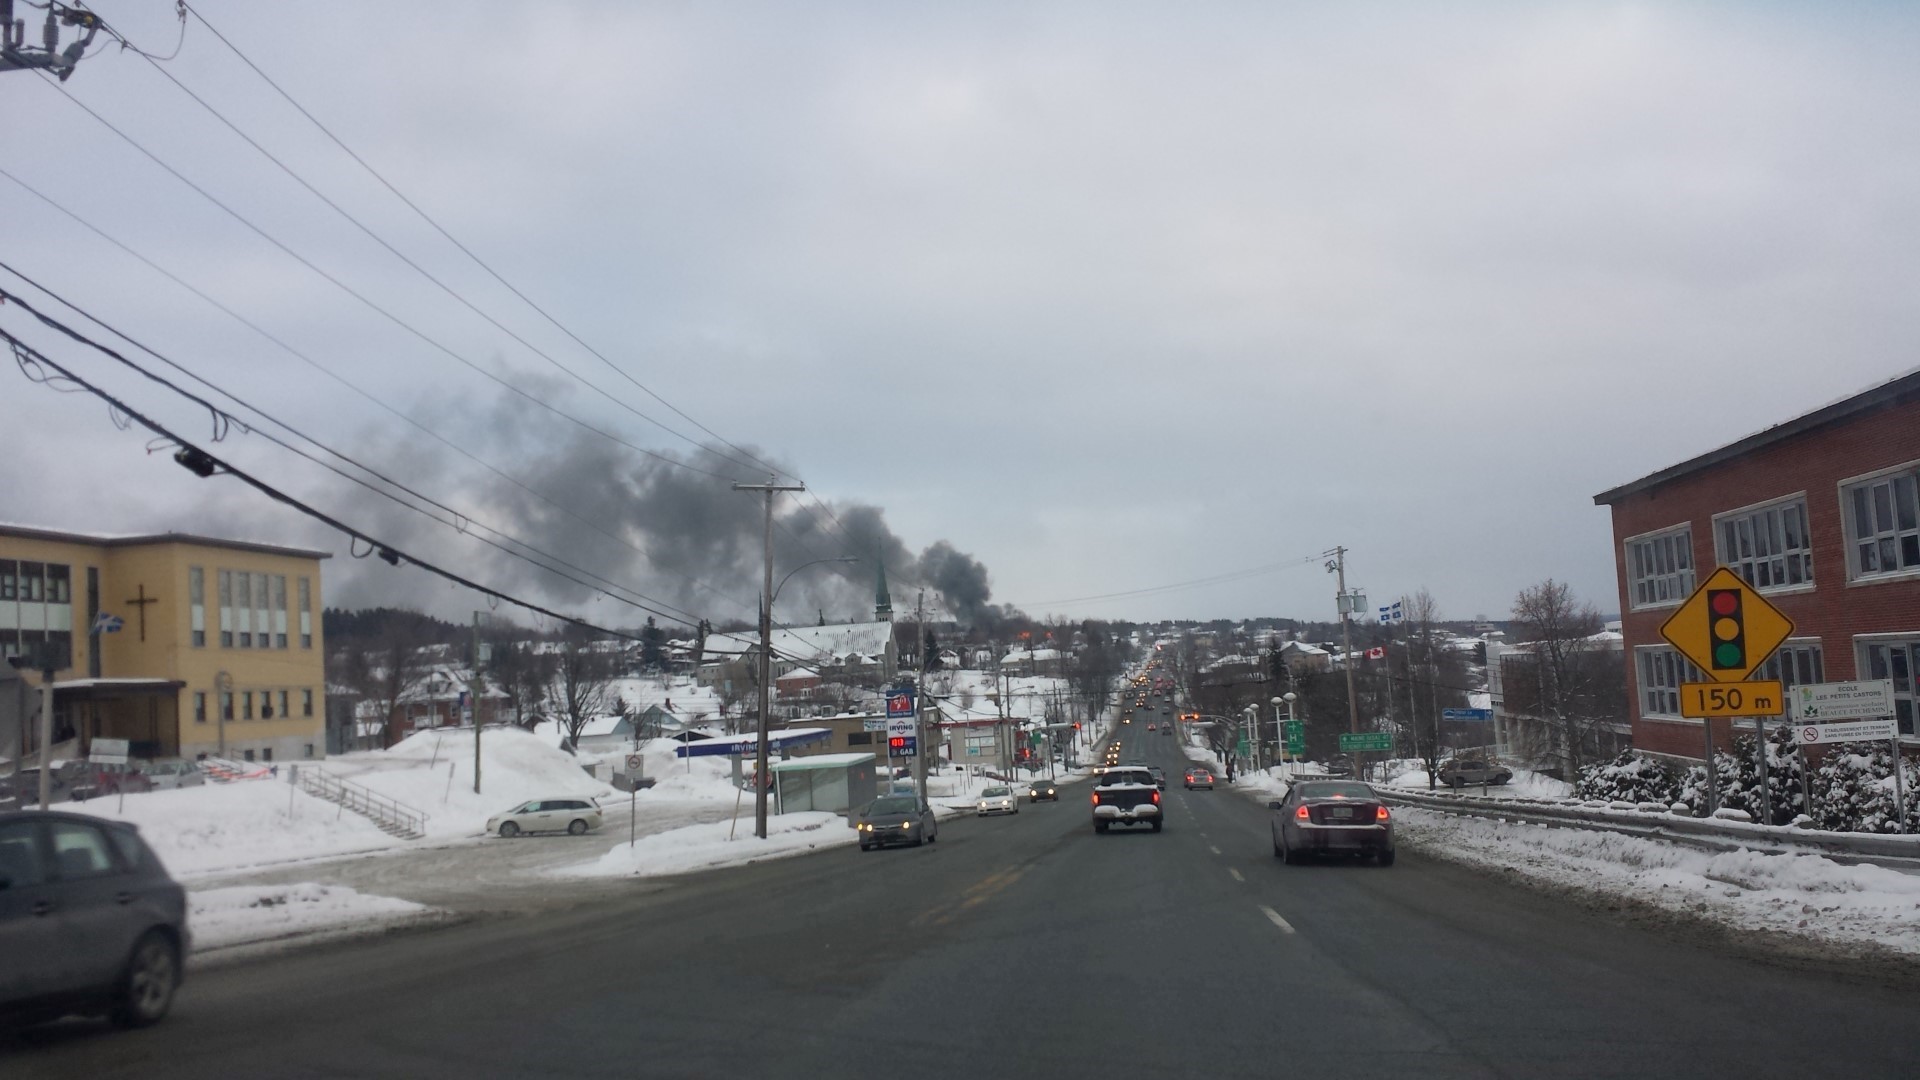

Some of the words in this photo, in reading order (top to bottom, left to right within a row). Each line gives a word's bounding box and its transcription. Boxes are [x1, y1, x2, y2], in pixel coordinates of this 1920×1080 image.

[1853, 690, 1882, 698] CASTORS
[1698, 688, 1743, 711] 150
[1754, 697, 1771, 708] m
[889, 723, 914, 732] IRVING
